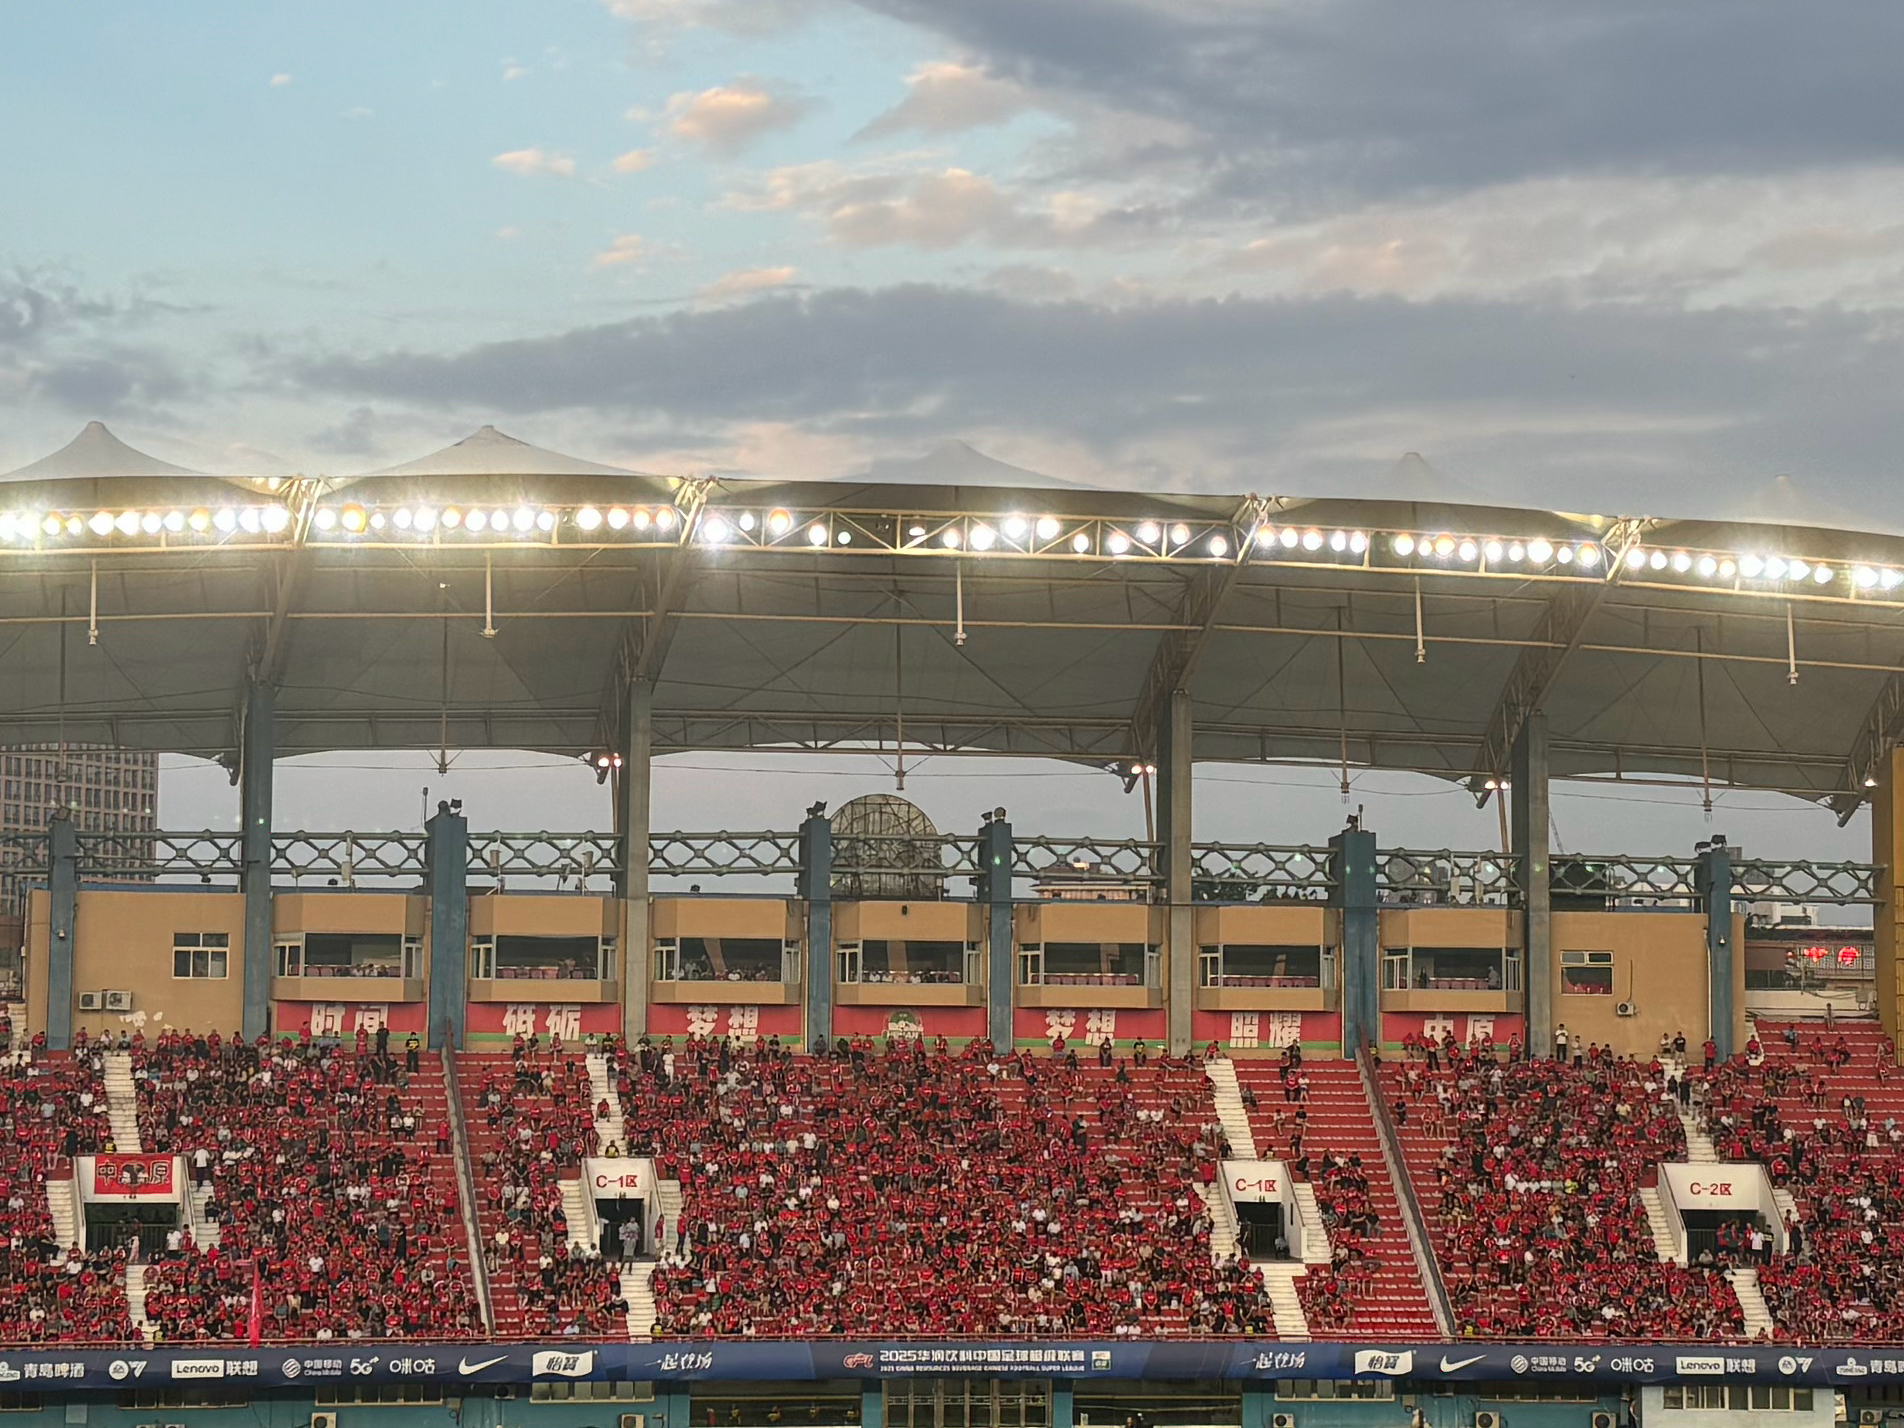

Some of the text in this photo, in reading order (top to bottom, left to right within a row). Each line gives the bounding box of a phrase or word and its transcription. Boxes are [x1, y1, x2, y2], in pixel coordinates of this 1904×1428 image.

[310, 1003, 389, 1037] 时间
[503, 1004, 581, 1041] 砥砺
[686, 1005, 759, 1041] 梦想
[1044, 1010, 1116, 1047] 梦想
[1230, 1012, 1300, 1048] 照耀
[596, 1175, 638, 1188] C-1区
[1235, 1178, 1277, 1192] C-1区
[1690, 1182, 1732, 1195] C-2区
[176, 1364, 219, 1374] Lenovo
